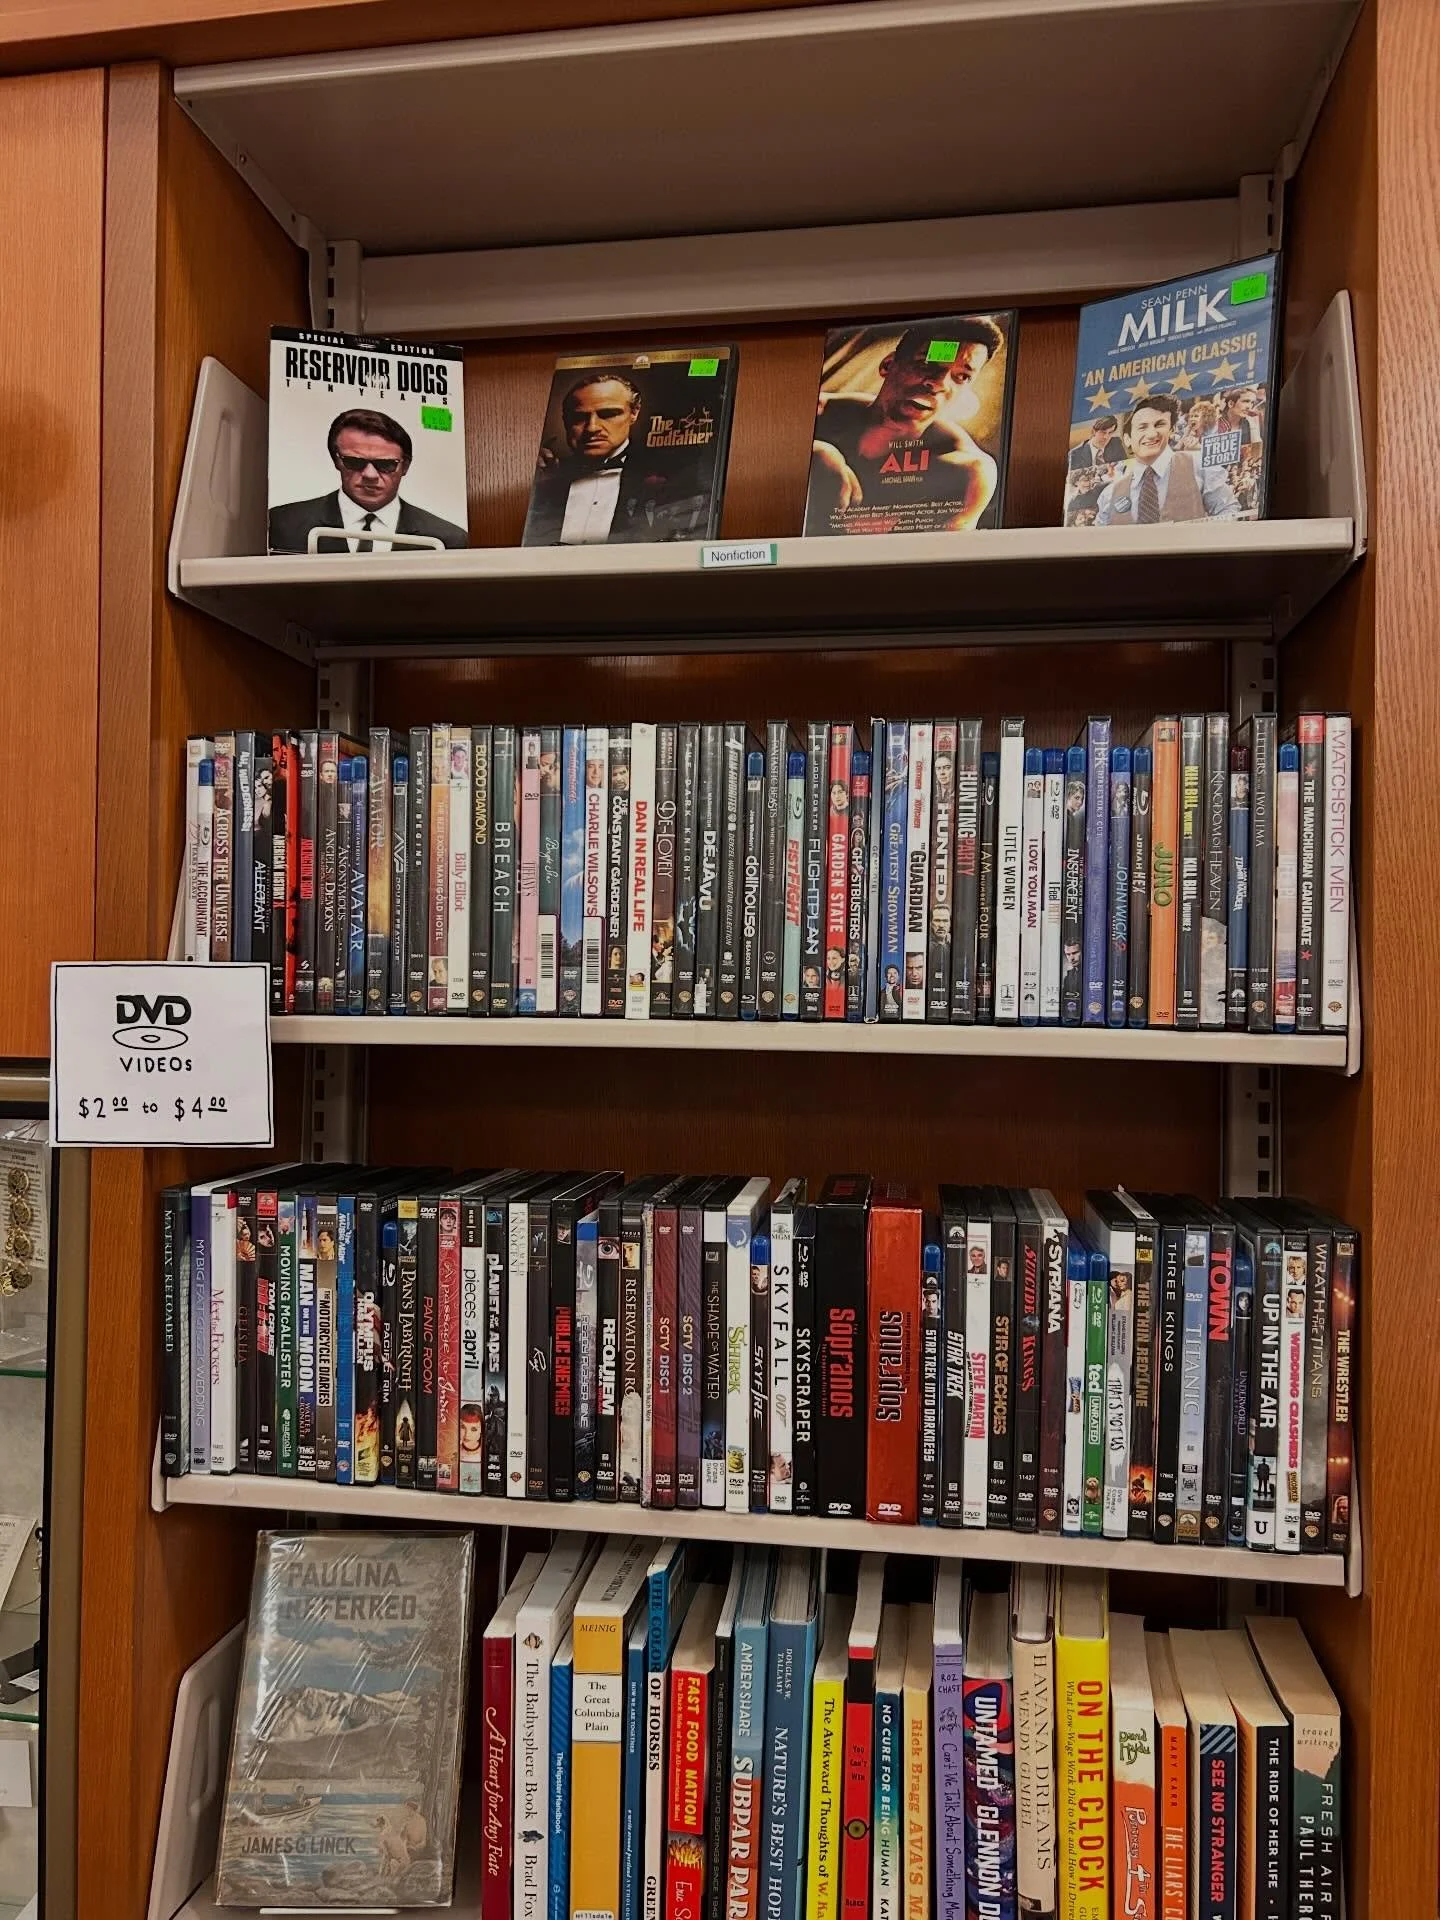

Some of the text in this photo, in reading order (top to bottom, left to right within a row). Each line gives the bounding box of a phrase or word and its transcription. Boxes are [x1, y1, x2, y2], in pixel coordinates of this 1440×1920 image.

[1117, 288, 1230, 347] MILK
[1141, 284, 1207, 310] SEAN PENN
[286, 346, 448, 396] RESERVOIR DOGS
[299, 332, 345, 345] SPECIAL
[391, 344, 435, 355] EDITION
[1109, 349, 1187, 382] AMERICAN
[646, 430, 713, 448] Godfather
[650, 415, 673, 434] The
[879, 450, 930, 474] ALI
[1203, 452, 1239, 467] STORY
[1205, 440, 1239, 457] TRUE
[711, 549, 765, 562] Nonfiction
[476, 745, 487, 845] BLOOD DIAMOND
[1330, 730, 1346, 913] MATCHSTICK MEN
[196, 861, 208, 937] THE ACCOUNTANT
[215, 808, 231, 942] ACROSS THE UNIVERSE
[253, 861, 266, 933] ALLEGIANT
[337, 847, 348, 920] ANONYMOUS
[452, 852, 466, 912] Billy Elliot
[493, 822, 510, 913] BREACH
[587, 794, 600, 916] CHARLIE WILSON'S
[609, 795, 622, 938] CONSTANT GARDENER
[634, 801, 647, 932] DAN IN REAL LIFE
[745, 855, 759, 937] dollhouse
[806, 838, 820, 954] FLIGHTPLAN
[830, 834, 844, 932] GARDEN STATE
[888, 823, 903, 952] GREATEST SHOWMAN
[909, 850, 926, 932] GUARDIAN
[1003, 826, 1018, 910] LITTLE WOMEN
[1027, 874, 1037, 899] YOU,
[1029, 844, 1038, 871] LOVE
[1154, 842, 1173, 907] JUNO
[1301, 780, 1315, 945] THE MANCHURIAN CANDIDATE
[350, 869, 364, 952] AVATAR
[725, 904, 733, 946] COLLECTION
[1028, 901, 1036, 928] MAN
[116, 995, 192, 1026] DVD
[143, 1102, 158, 1114] to
[164, 1210, 175, 1352] MATRIX RELOADED
[280, 1246, 290, 1301] MOVING
[707, 1295, 719, 1339] SHAPE
[1022, 1244, 1036, 1392] SUICIDE KINGS
[1047, 1244, 1063, 1333] SYRIANA
[1164, 1243, 1177, 1372] THREE KINGS
[1209, 1247, 1231, 1340] TOWN
[319, 1300, 332, 1405] MOTORCYCLE DIARIES
[399, 1268, 415, 1392] PAN'S LABYRINTH
[423, 1296, 433, 1394] PANIC ROOM
[462, 1268, 480, 1369] pieces april
[555, 1307, 570, 1416] PUBLIC ENEMIES
[624, 1278, 637, 1373] RESERVATION
[774, 1265, 789, 1387] SKYFALL
[824, 1308, 856, 1418] Sopranos
[1260, 1293, 1277, 1428] UP IN THE AIR
[707, 1353, 719, 1399] WATER
[796, 1328, 810, 1442] SKYSCRAPER
[923, 1329, 936, 1462] STAR TREK INTO DARKNESS
[971, 1353, 986, 1439] STEVE MARTIN
[1089, 1364, 1103, 1443] ted UNRATED
[1335, 1329, 1350, 1422] THE WRESTLER
[288, 1562, 402, 1588] PAULINA
[575, 1708, 620, 1718] Columbia
[584, 1695, 610, 1705] Great
[585, 1722, 609, 1732] Plain
[588, 1681, 607, 1691] The
[648, 1678, 661, 1770] OF HORSES
[522, 1659, 539, 1819] The Bathysphere Book
[684, 1677, 700, 1825] FAST FOOD NATION
[1033, 1654, 1051, 1870] HAVANA DREAMS
[1170, 1736, 1178, 1807] MARY KARR
[484, 1707, 506, 1876] A Heart for Any Fate
[880, 1704, 891, 1887] NO CURE FOR BEING HUMAN
[974, 1696, 1000, 1897] UNTAMED GLENNON
[1077, 1680, 1104, 1892] ON THE CLOCK
[1211, 1759, 1225, 1902] SEE NO STRANGER
[1268, 1739, 1279, 1888] THE RIDE OF HER LIFE
[242, 1836, 295, 1854] JAMES
[311, 1837, 356, 1855] LINCK
[1320, 1783, 1333, 1902] FRESH AIR
